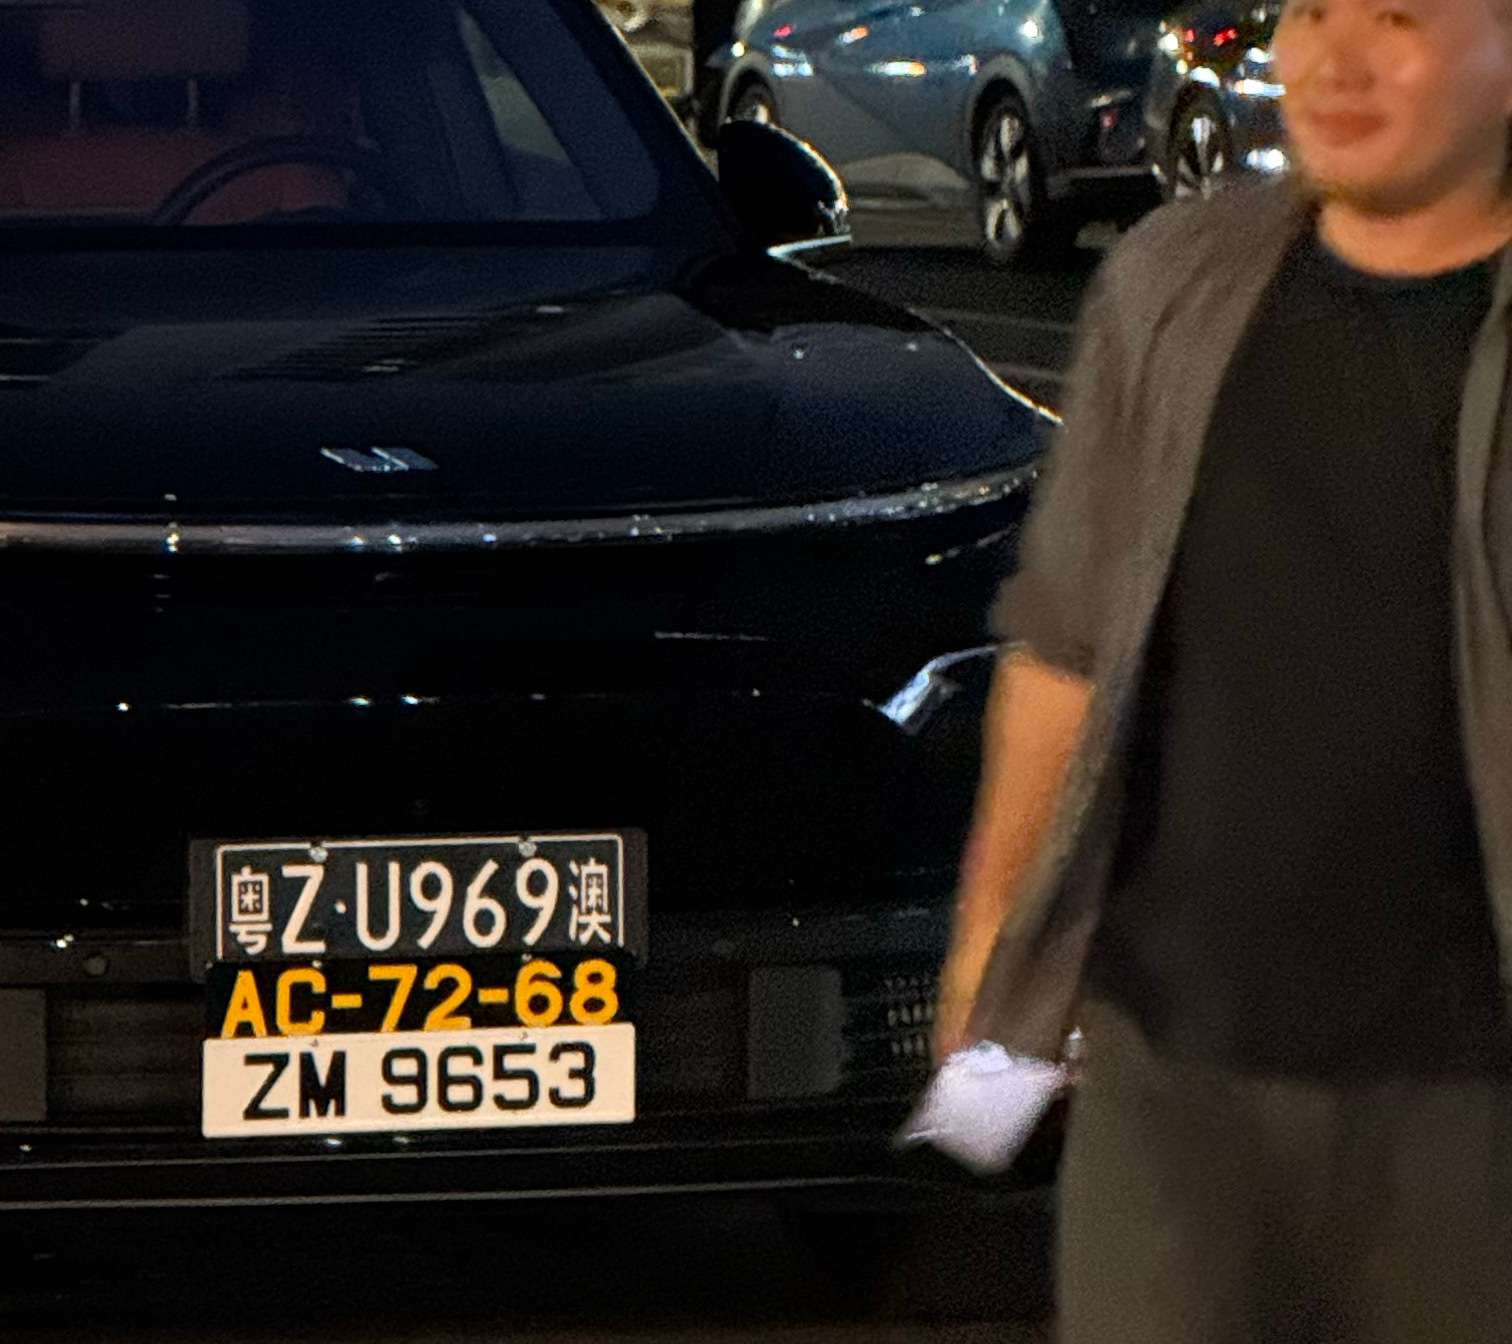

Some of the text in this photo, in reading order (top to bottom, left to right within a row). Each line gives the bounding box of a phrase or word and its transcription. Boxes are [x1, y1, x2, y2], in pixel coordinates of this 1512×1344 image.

[221, 959, 619, 1039] AC-72-68
[243, 1041, 596, 1121] ZM 9653
